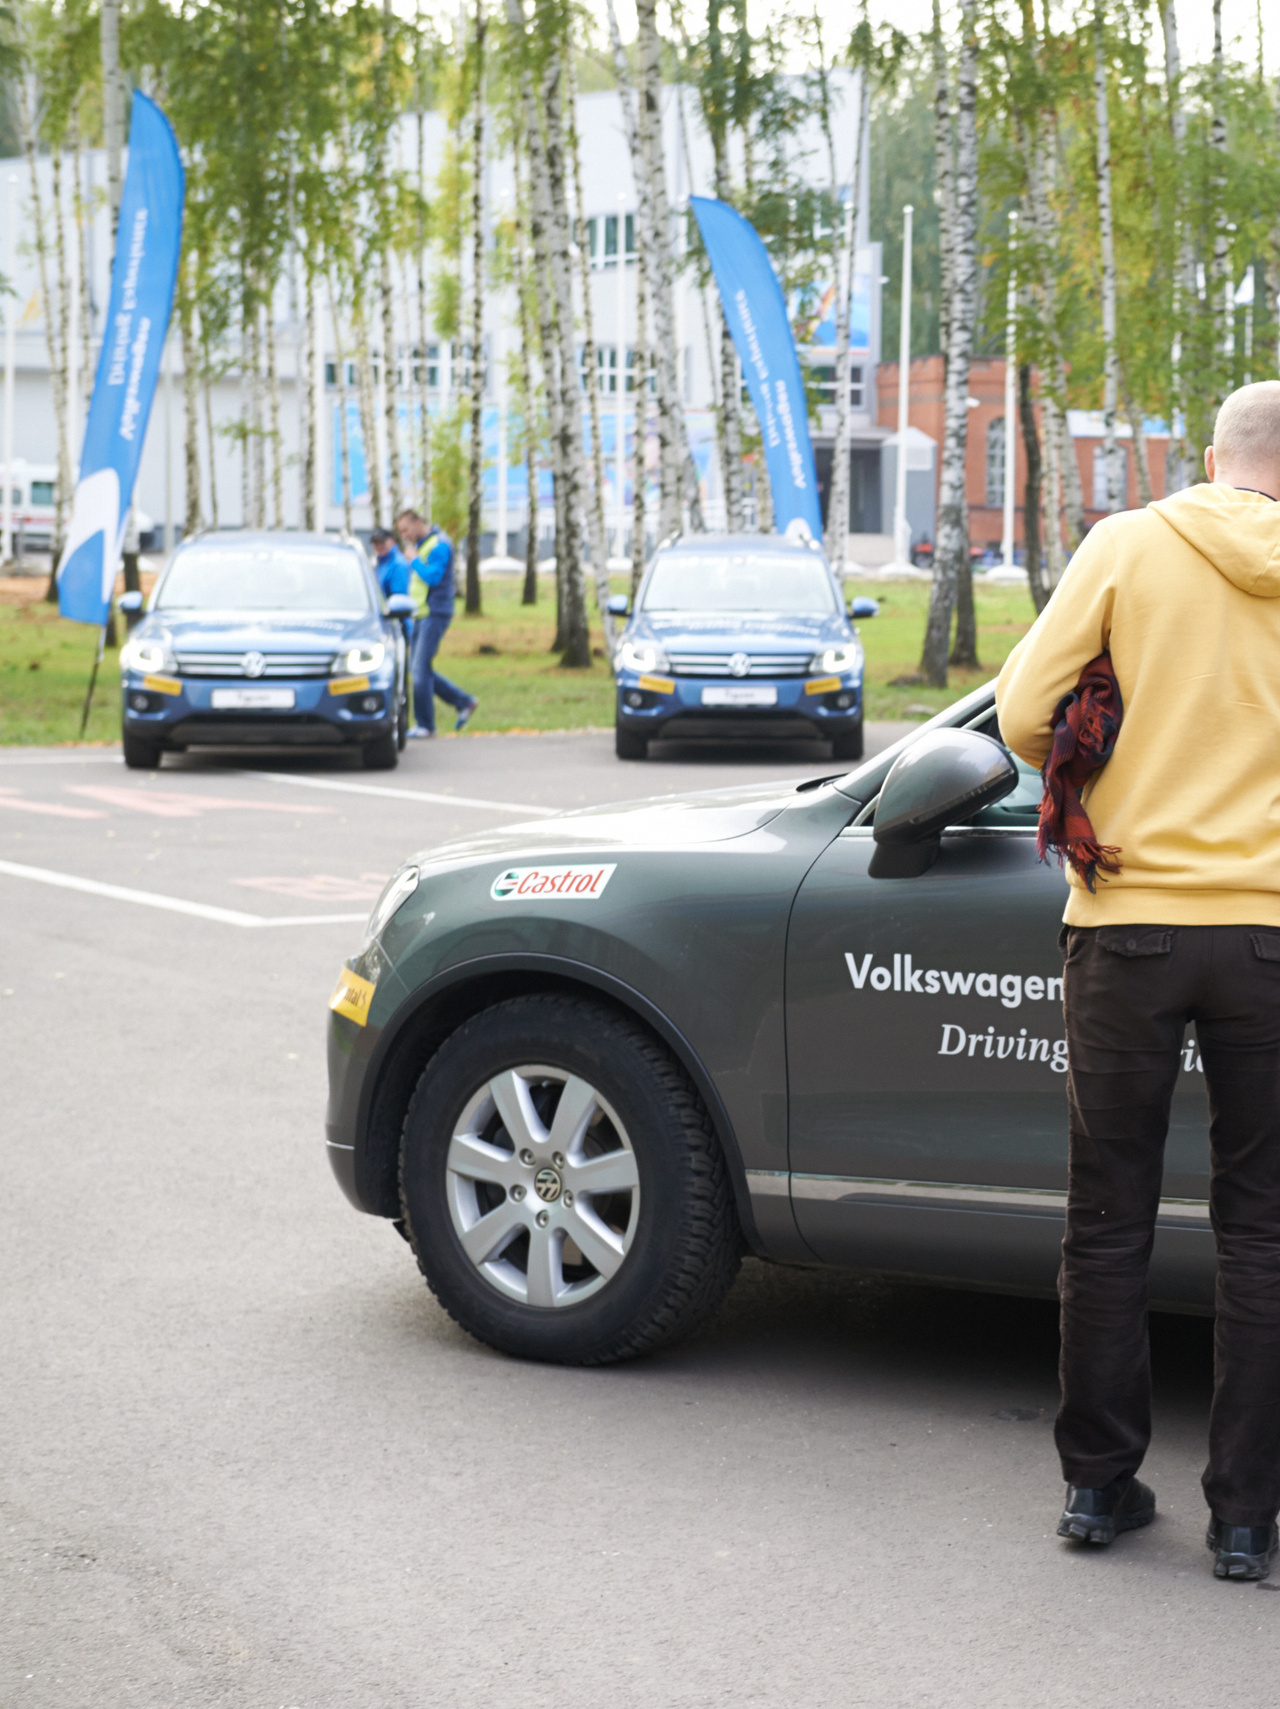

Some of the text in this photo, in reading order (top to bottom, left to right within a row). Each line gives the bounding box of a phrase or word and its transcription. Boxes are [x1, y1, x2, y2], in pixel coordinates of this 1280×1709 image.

[517, 869, 605, 894] Castrol
[844, 952, 1065, 1009] Volkswagen
[937, 1023, 1069, 1073] Driving
